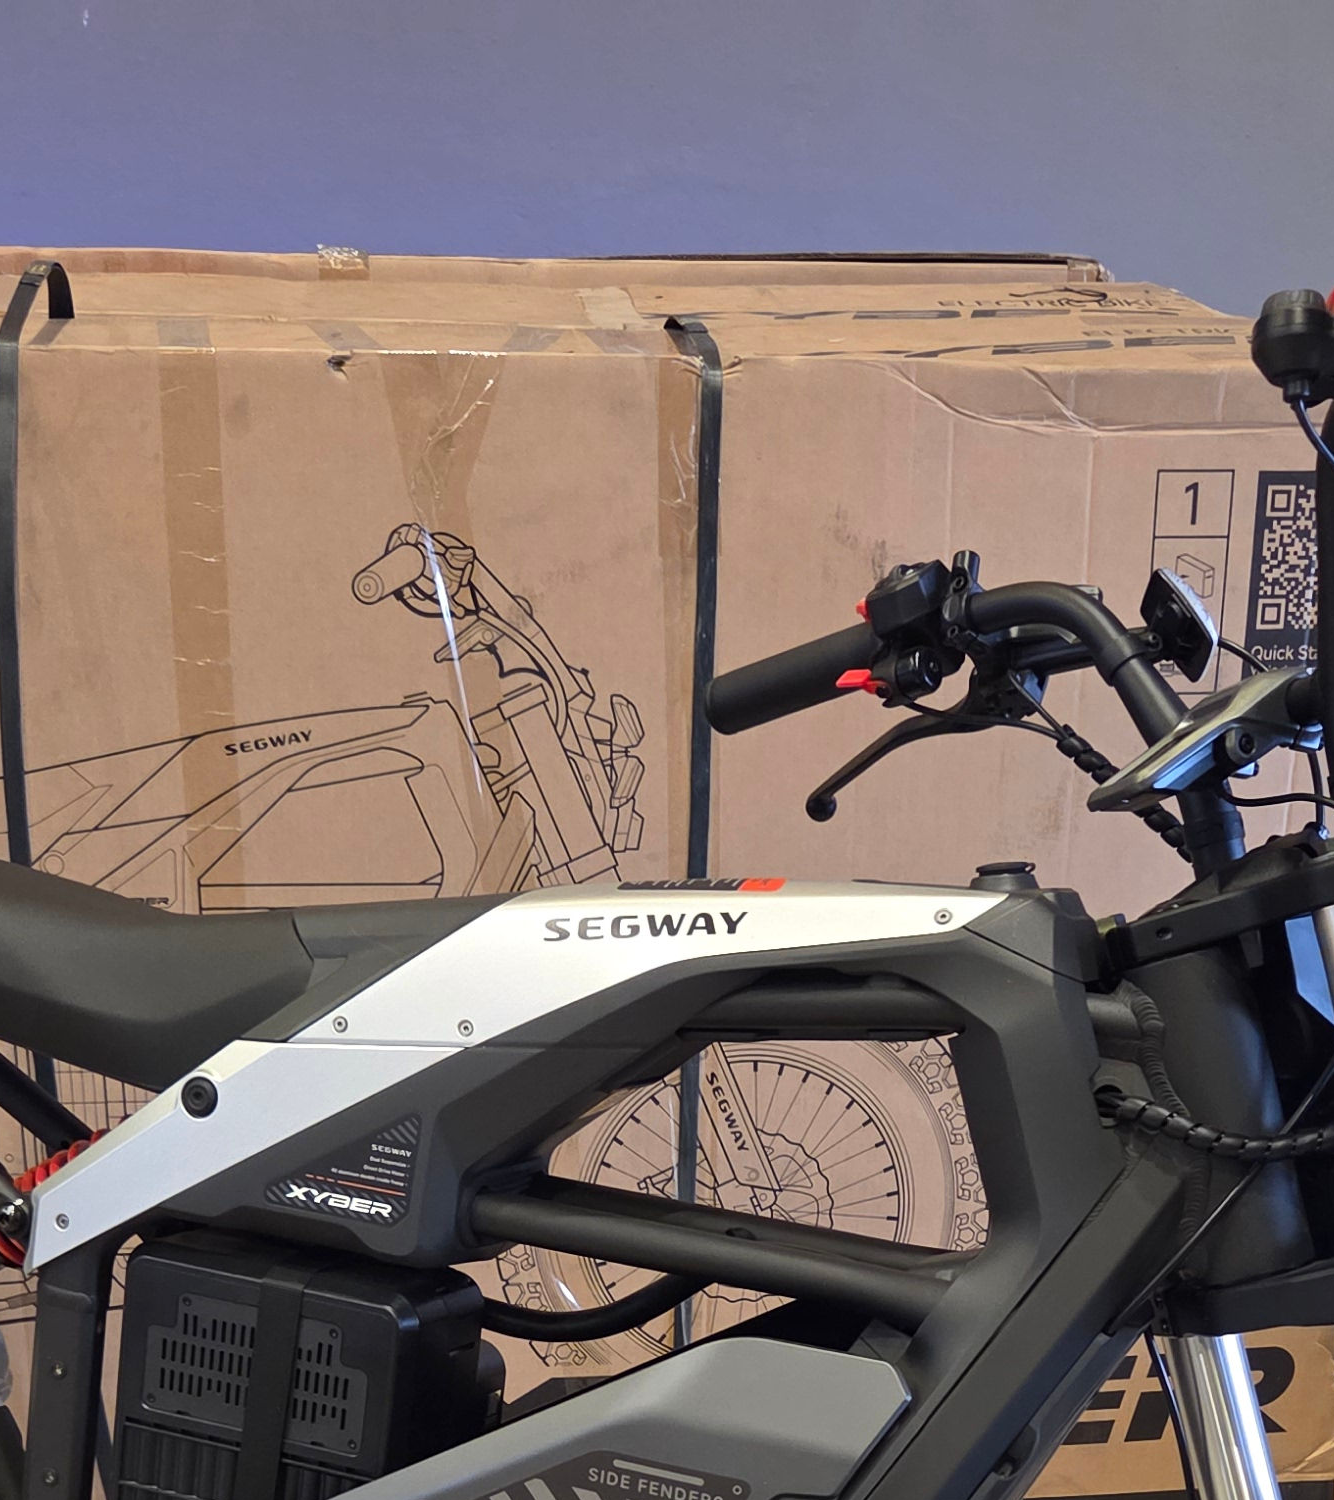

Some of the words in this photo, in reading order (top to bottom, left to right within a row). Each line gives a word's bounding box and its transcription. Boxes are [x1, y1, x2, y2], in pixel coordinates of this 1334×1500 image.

[1184, 481, 1200, 526] 1
[1252, 645, 1294, 661] Quick
[224, 730, 312, 756] SEGWAY
[543, 911, 749, 942] SEGWAY
[705, 1071, 750, 1152] SEGWAY
[371, 1143, 412, 1158] SEGWAY
[285, 1183, 393, 1218] XYBER
[588, 1467, 631, 1490] SIDE
